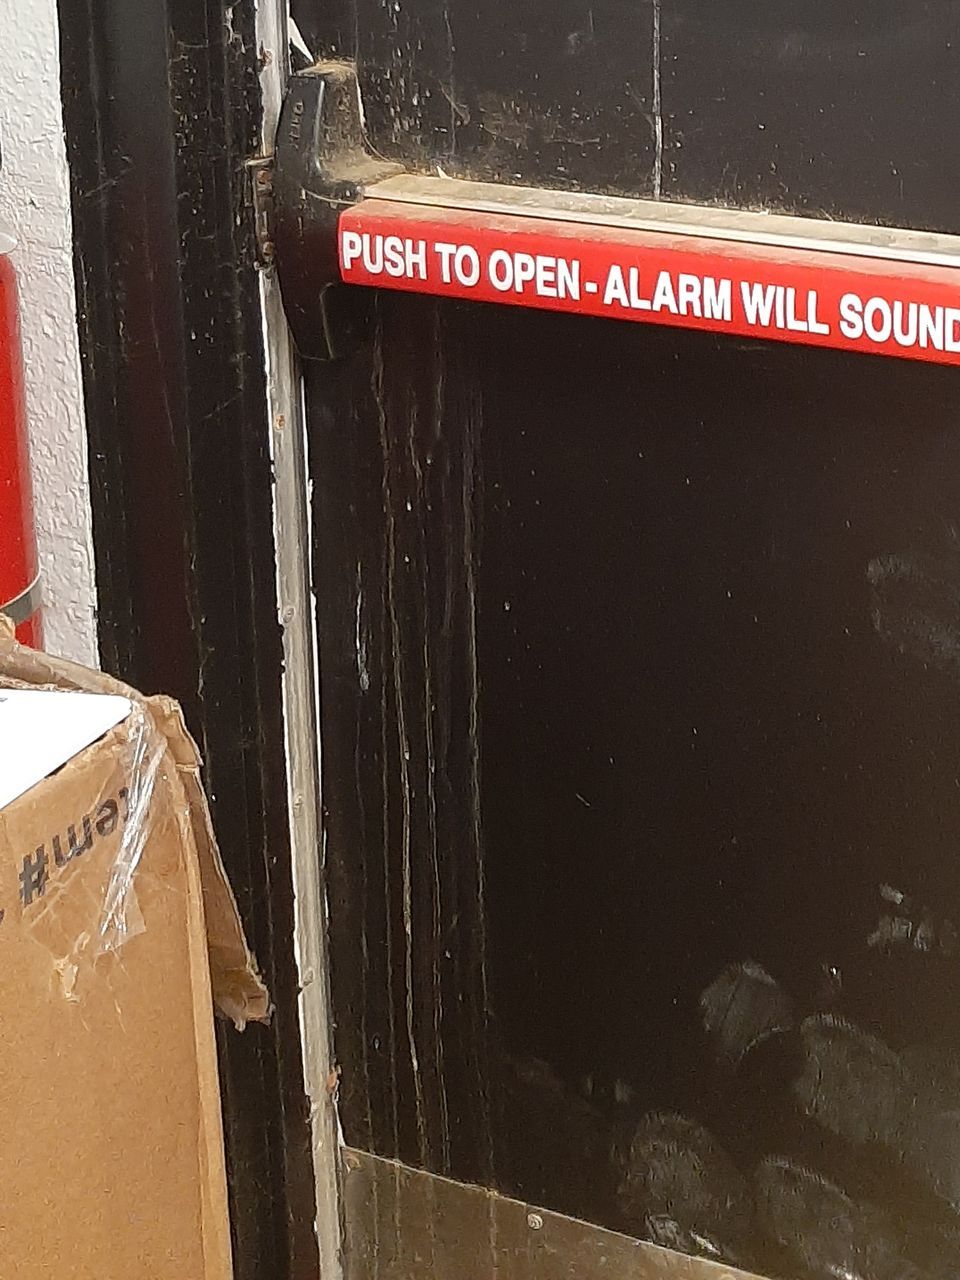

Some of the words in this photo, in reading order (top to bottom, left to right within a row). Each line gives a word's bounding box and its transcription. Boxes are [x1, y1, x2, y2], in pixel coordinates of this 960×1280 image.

[341, 230, 428, 280] PUSH
[434, 241, 481, 288] TO
[603, 264, 732, 322] ALARM
[740, 281, 830, 335] WILL
